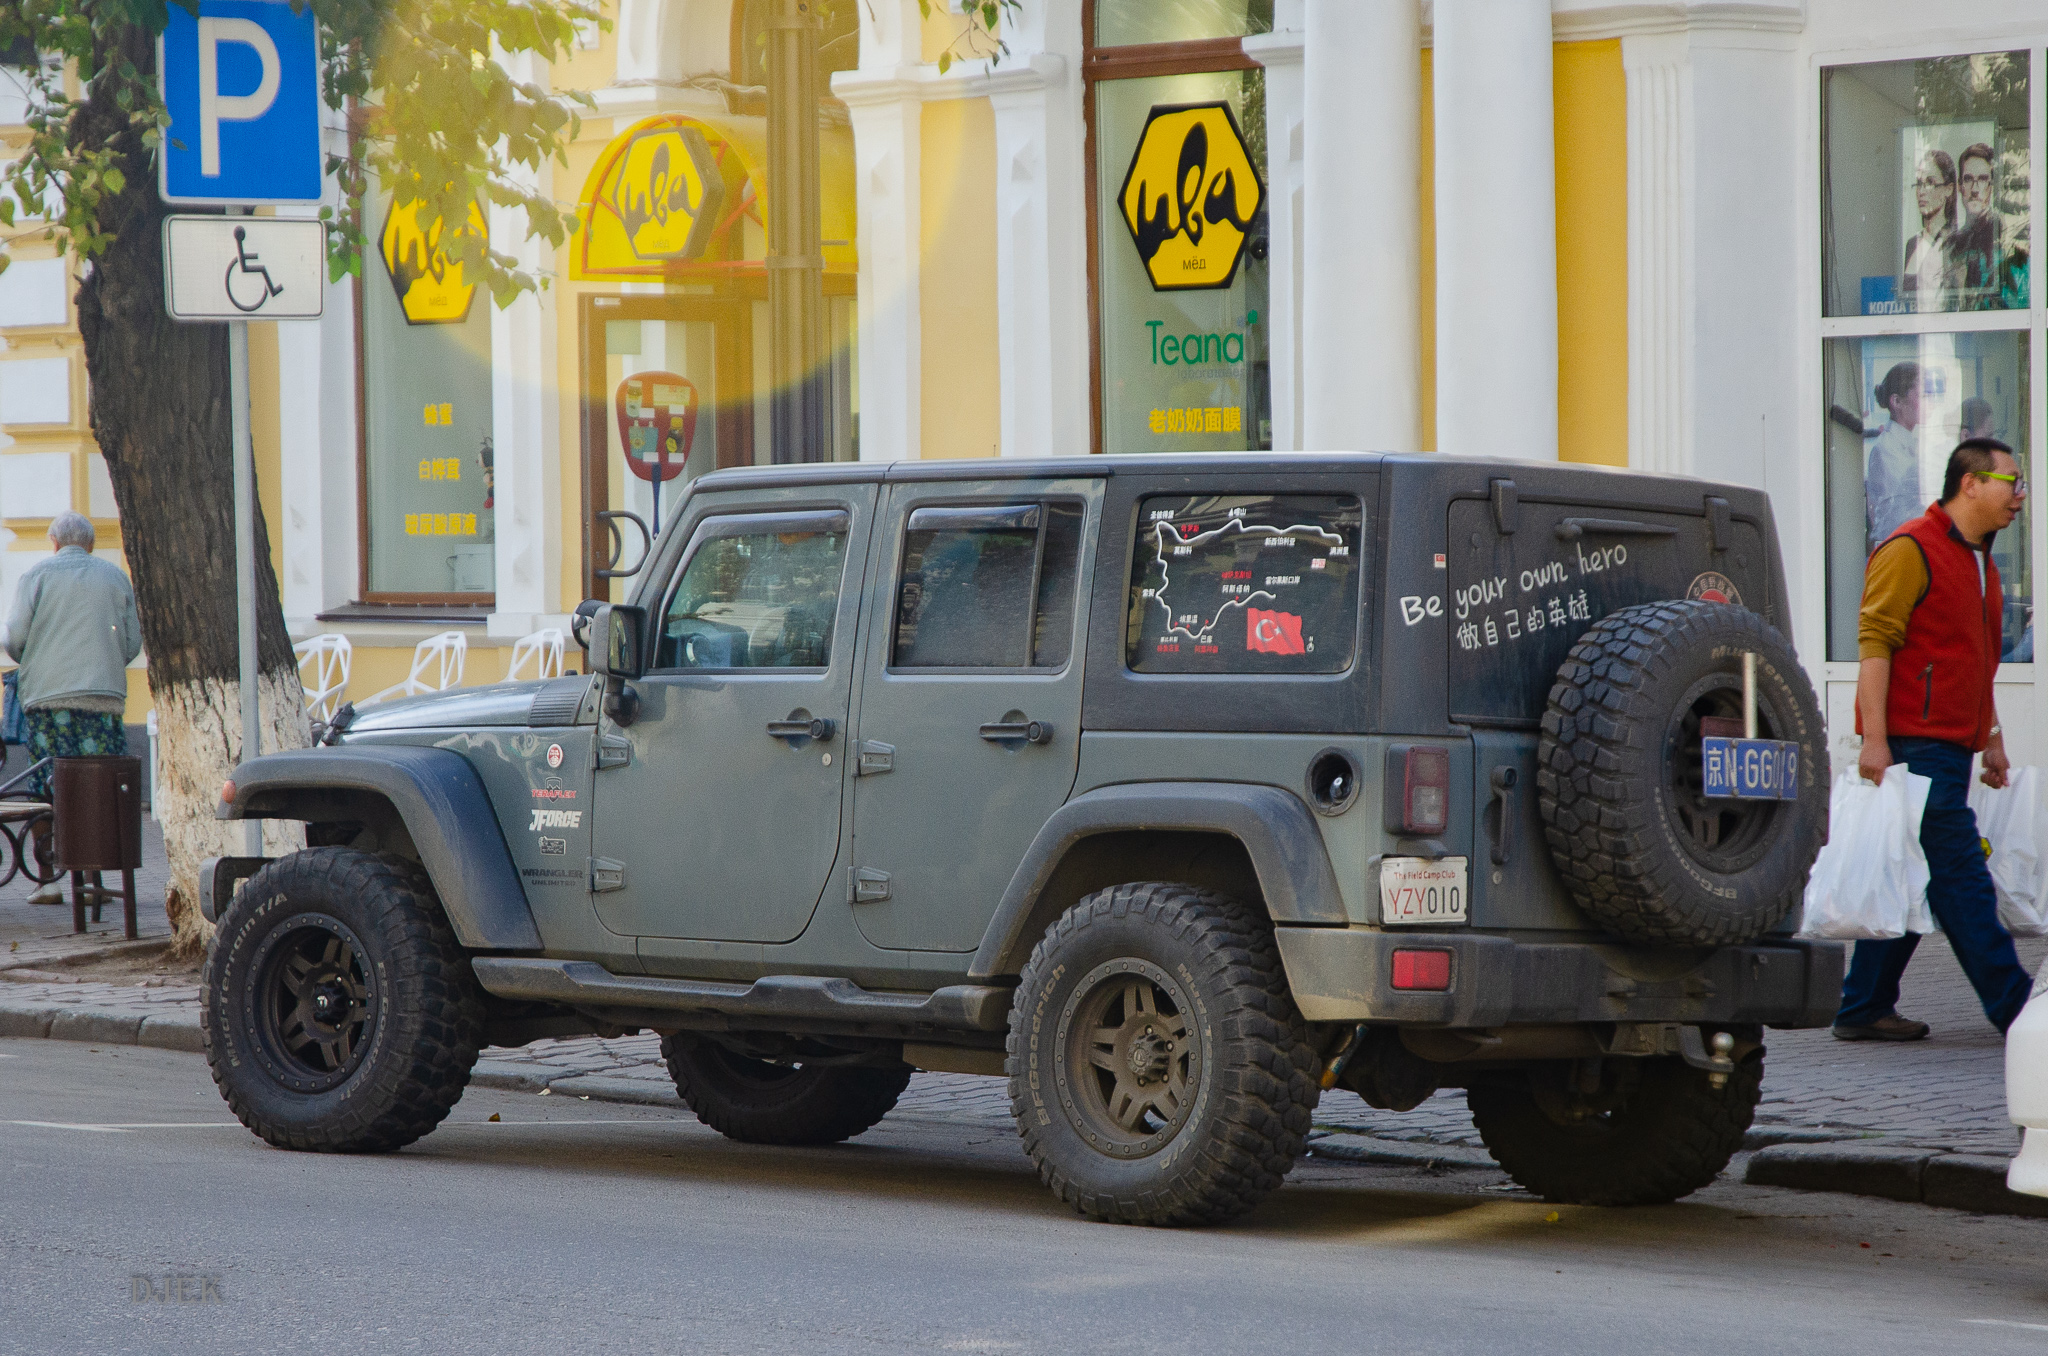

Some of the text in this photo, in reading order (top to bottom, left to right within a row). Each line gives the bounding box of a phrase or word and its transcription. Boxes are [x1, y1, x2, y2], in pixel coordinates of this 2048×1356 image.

[198, 16, 281, 177] P
[1182, 256, 1206, 271] мёд
[1869, 301, 1906, 315] КОГДА
[1145, 320, 1244, 365] Teana
[424, 402, 453, 426] 蜂蜜
[1149, 407, 1242, 433] 老奶奶面膜
[419, 458, 460, 480] 白桦茸
[1265, 537, 1296, 548] 新西伯利亚
[1222, 584, 1251, 594] 阿斯塔纳
[1400, 542, 1628, 626] Be your own hero
[1457, 589, 1592, 650] 做自己的英雄
[531, 789, 577, 799] TERAFLEX
[522, 868, 583, 878] WRANGLER
[1394, 870, 1456, 880] The Field Camp Club
[1388, 886, 1460, 915] YZY010
[220, 892, 288, 1067] Mud-Terrain T/A
[1029, 964, 1066, 1126] BFGoodrich
[1159, 1140, 1191, 1170] T/A
